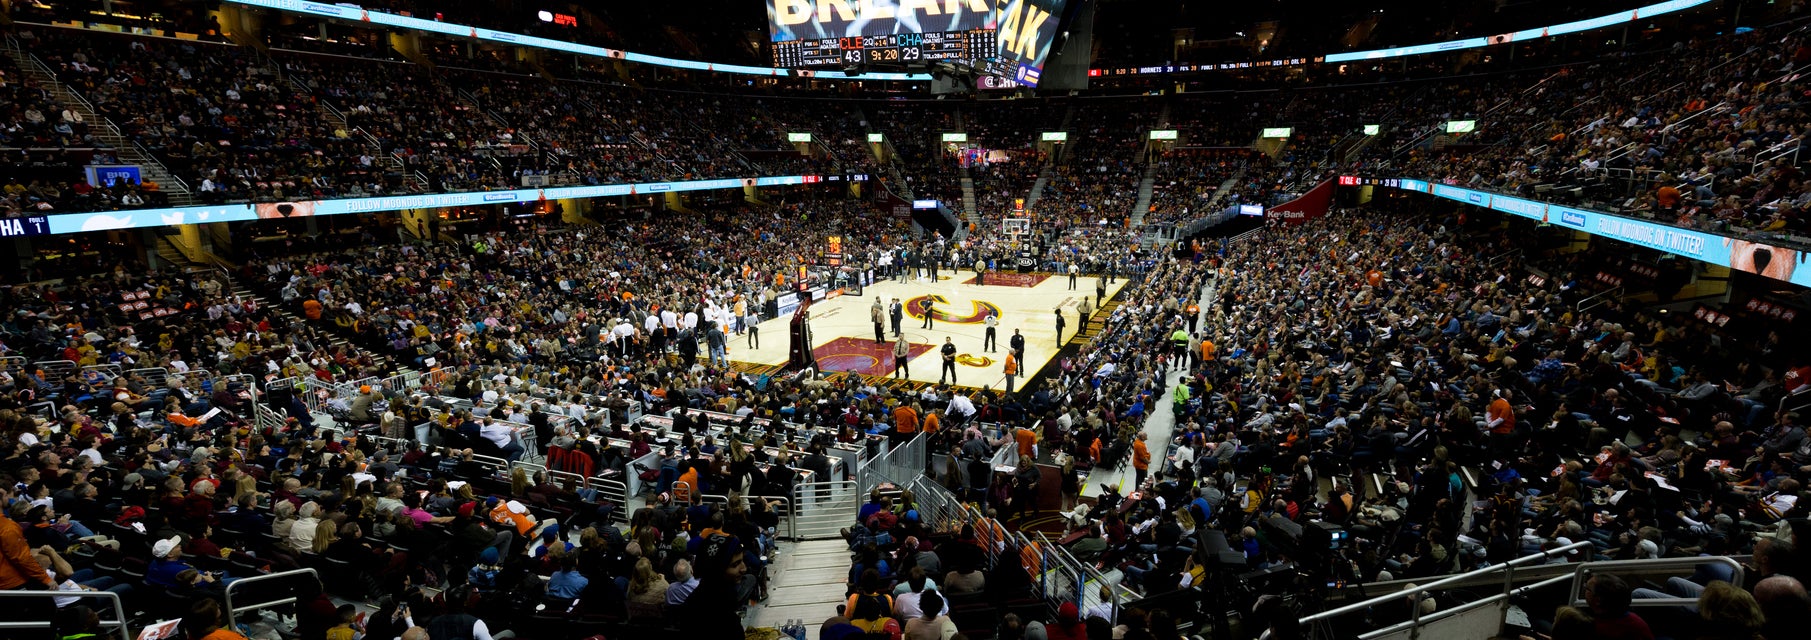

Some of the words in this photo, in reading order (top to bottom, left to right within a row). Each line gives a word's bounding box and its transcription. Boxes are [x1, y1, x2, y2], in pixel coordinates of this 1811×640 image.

[774, 0, 989, 25] BRE
[840, 36, 863, 50] CLE
[898, 34, 922, 46] CHA
[846, 50, 860, 62] 43
[903, 48, 919, 60] 29
[346, 200, 380, 211] FOLLOW
[383, 197, 422, 209] MOONDOG
[426, 197, 435, 205] ON
[438, 195, 470, 204] TWITTER!
[0, 218, 25, 236] HA
[35, 223, 42, 234] 1
[1599, 217, 1620, 235] FOLLOW
[1622, 221, 1653, 242] MOONDOG
[1655, 229, 1665, 244] ON
[1667, 231, 1704, 254] TWITTER!
